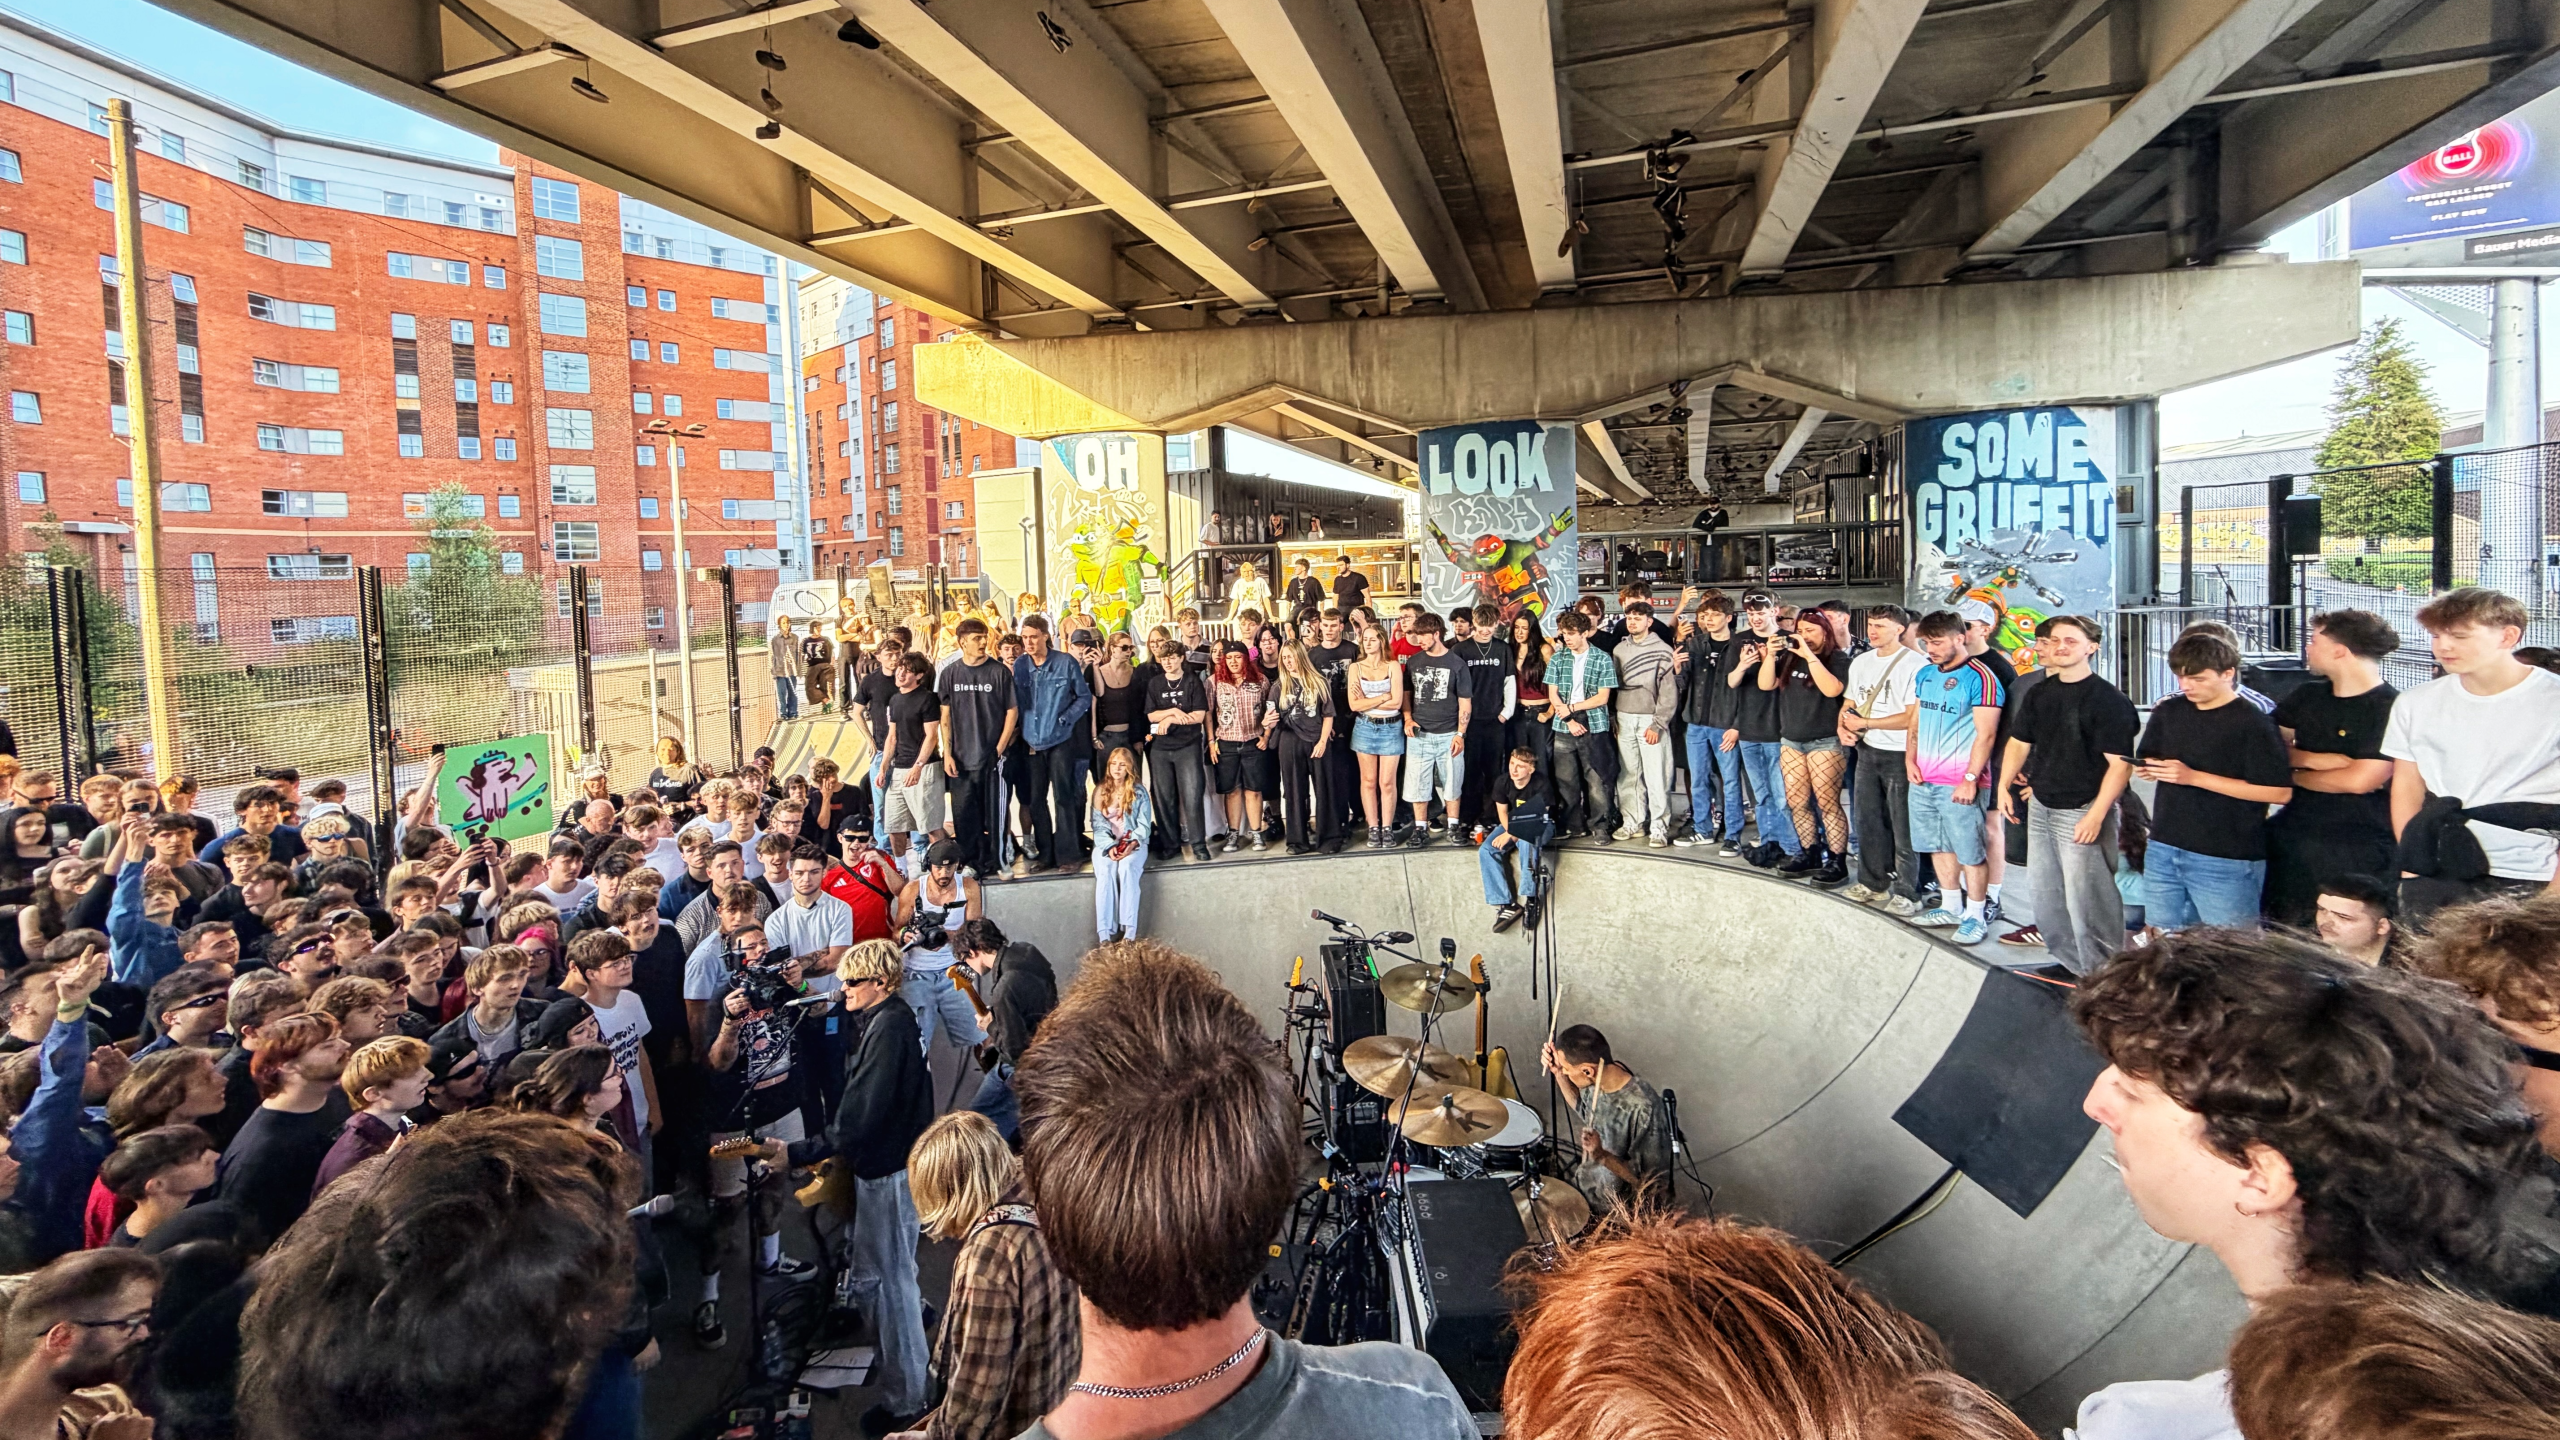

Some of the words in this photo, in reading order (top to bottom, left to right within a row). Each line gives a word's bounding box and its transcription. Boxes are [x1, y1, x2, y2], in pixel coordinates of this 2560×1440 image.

[2474, 241, 2517, 254] Bauer
[1075, 437, 1139, 491] OH
[1428, 432, 1554, 498] LOOK
[1938, 412, 2089, 487] SOME
[1456, 1112, 1493, 1133] K
